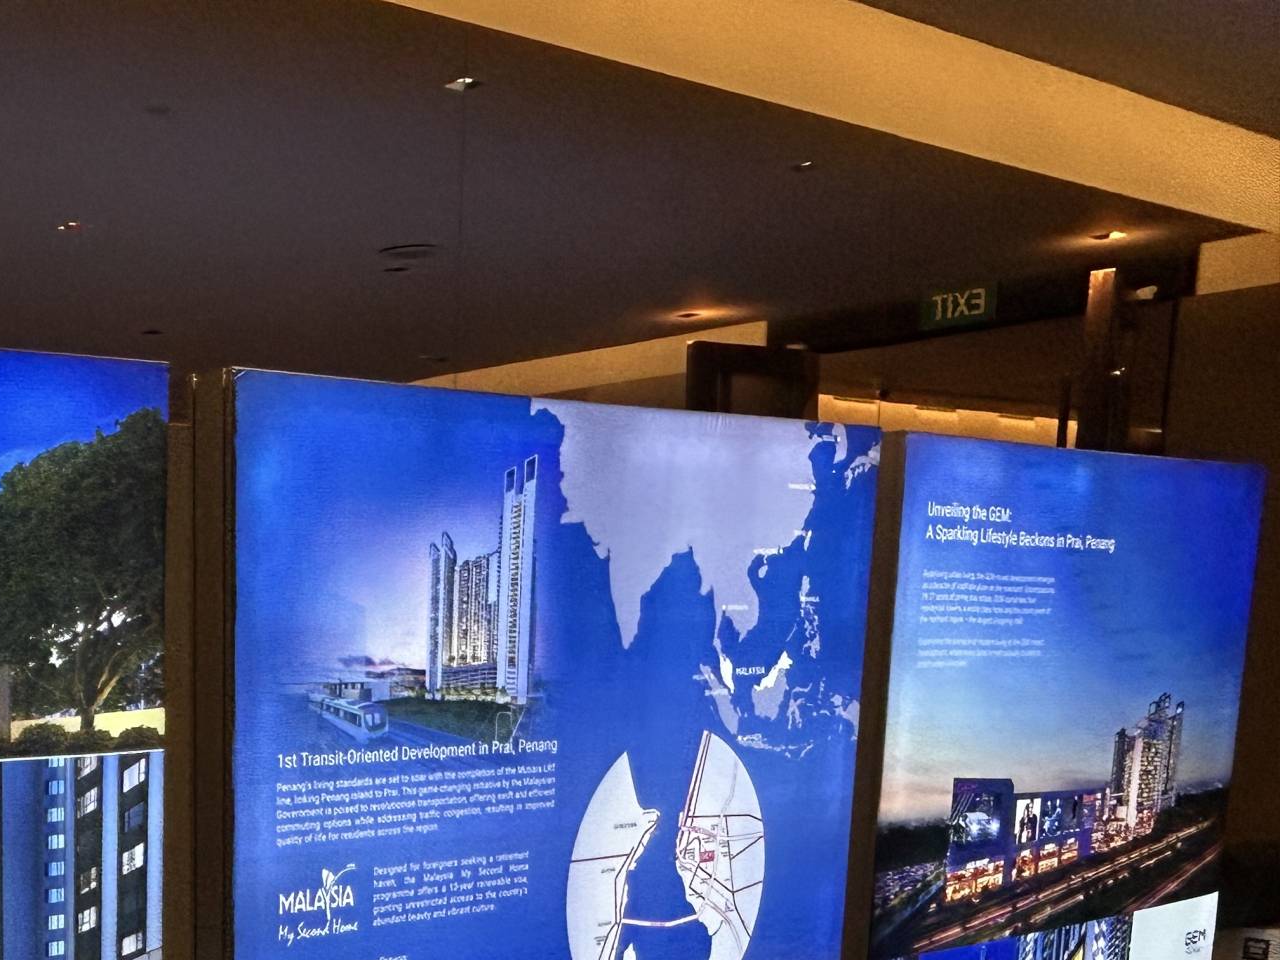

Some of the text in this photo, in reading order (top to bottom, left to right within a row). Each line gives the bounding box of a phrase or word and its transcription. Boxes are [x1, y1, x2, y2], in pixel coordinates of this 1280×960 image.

[928, 501, 971, 522] Unveiling
[972, 504, 987, 520] the
[926, 524, 934, 539] A
[936, 524, 979, 546] Sparkling
[980, 528, 1018, 548] Lifestyle
[1019, 531, 1055, 547] Beckons
[1056, 533, 1064, 547] in
[277, 753, 297, 768] 1st
[301, 746, 399, 767] Transit-Oriented
[402, 742, 476, 763] Development
[479, 742, 488, 755] in
[518, 738, 558, 755] Penang
[279, 885, 354, 916] MALAYSIA
[278, 917, 358, 946] My Second Home
